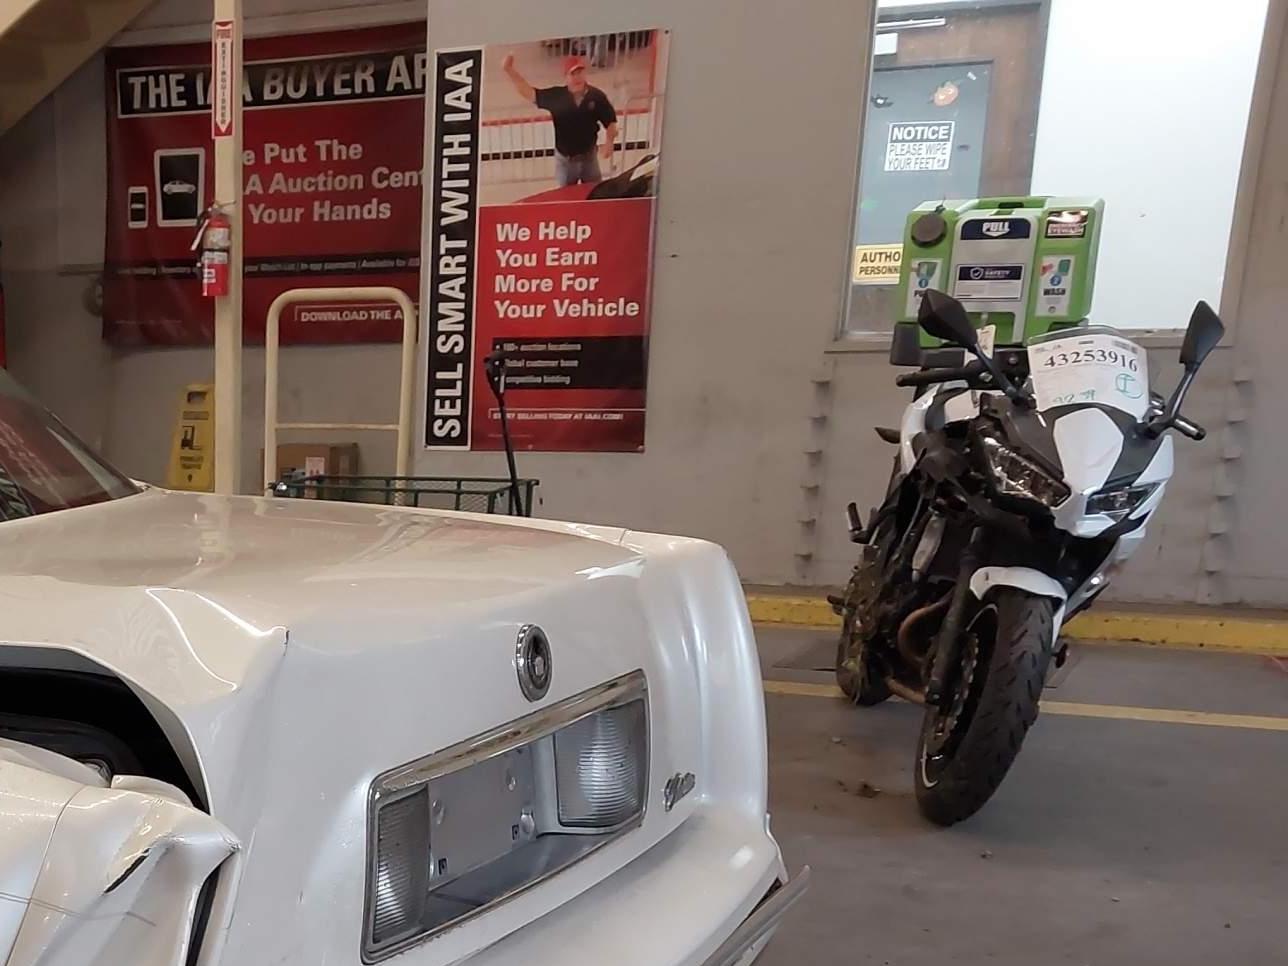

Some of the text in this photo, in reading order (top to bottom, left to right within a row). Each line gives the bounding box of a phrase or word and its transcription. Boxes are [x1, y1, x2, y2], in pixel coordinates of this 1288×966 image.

[128, 74, 187, 110] THE
[263, 59, 376, 101] BUYER
[892, 126, 950, 141] NOTICE
[264, 143, 307, 165] Put
[314, 138, 363, 162] The
[889, 142, 947, 156] PLEASE WIPE
[887, 156, 936, 169] YOUR FEET
[268, 168, 364, 194] Auction
[248, 198, 392, 224] Your Hands
[496, 220, 592, 244] We Help
[982, 221, 1010, 232] PULL
[433, 58, 475, 438] SELL SMART WITH IAA
[496, 248, 598, 268] You Earn
[494, 273, 599, 293] More For
[1043, 288, 1066, 296] WASH
[301, 310, 368, 322] DOWNLOAD
[370, 309, 392, 321] THE
[494, 297, 640, 319] Your Vehicle
[1044, 349, 1138, 372] 43253916
